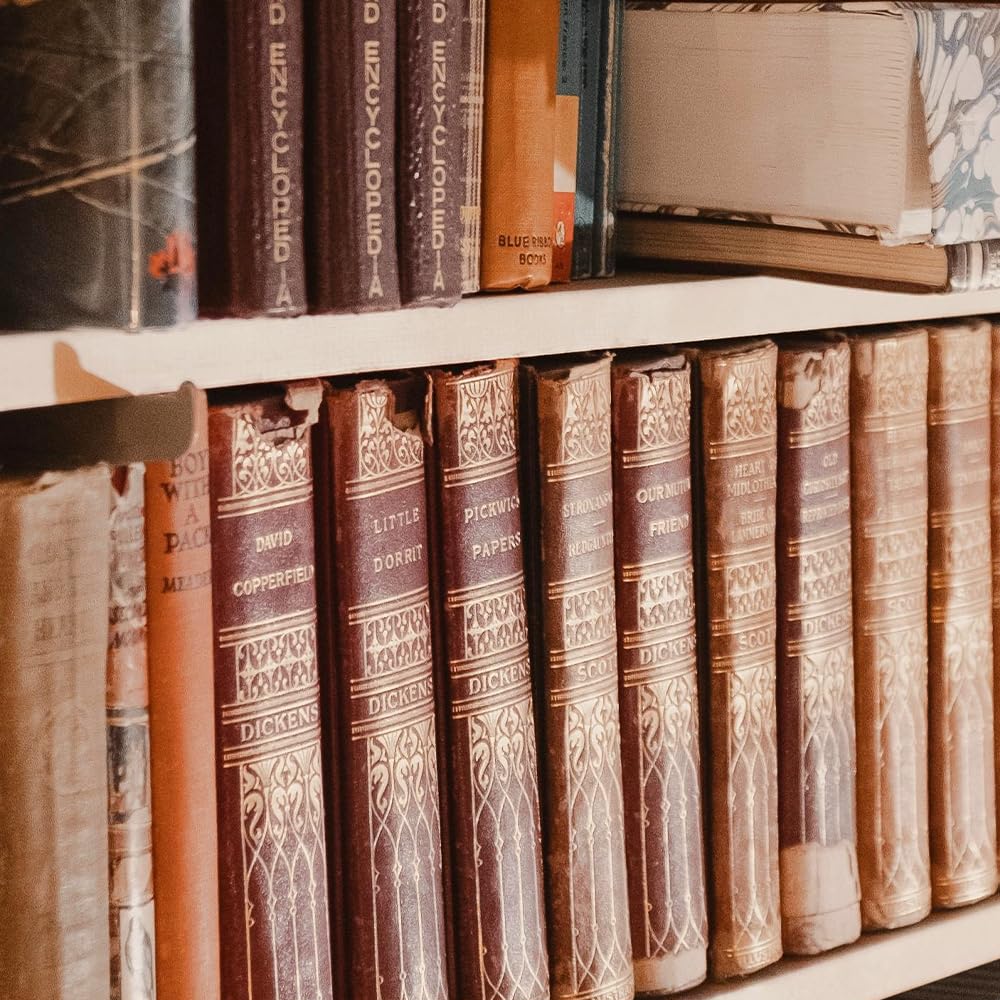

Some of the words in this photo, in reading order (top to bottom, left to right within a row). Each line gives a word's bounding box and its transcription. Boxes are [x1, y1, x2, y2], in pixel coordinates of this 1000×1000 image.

[269, 42, 293, 307] ENCYCLOPEDIA
[364, 40, 384, 299] ENCYCLOPEDIA
[431, 40, 447, 291] ENCYCLOPEDIA
[498, 234, 530, 248] BLUE
[519, 253, 547, 265] BOOKS
[374, 507, 420, 534] LITTLE
[255, 528, 293, 553] DAVID
[472, 531, 521, 561] PAPERS
[374, 543, 423, 573] DORRIT
[232, 564, 315, 597] COPPERFIELD
[468, 658, 531, 696] DICKENS
[368, 677, 433, 716] DICKENS
[240, 703, 319, 742] DICKENS
